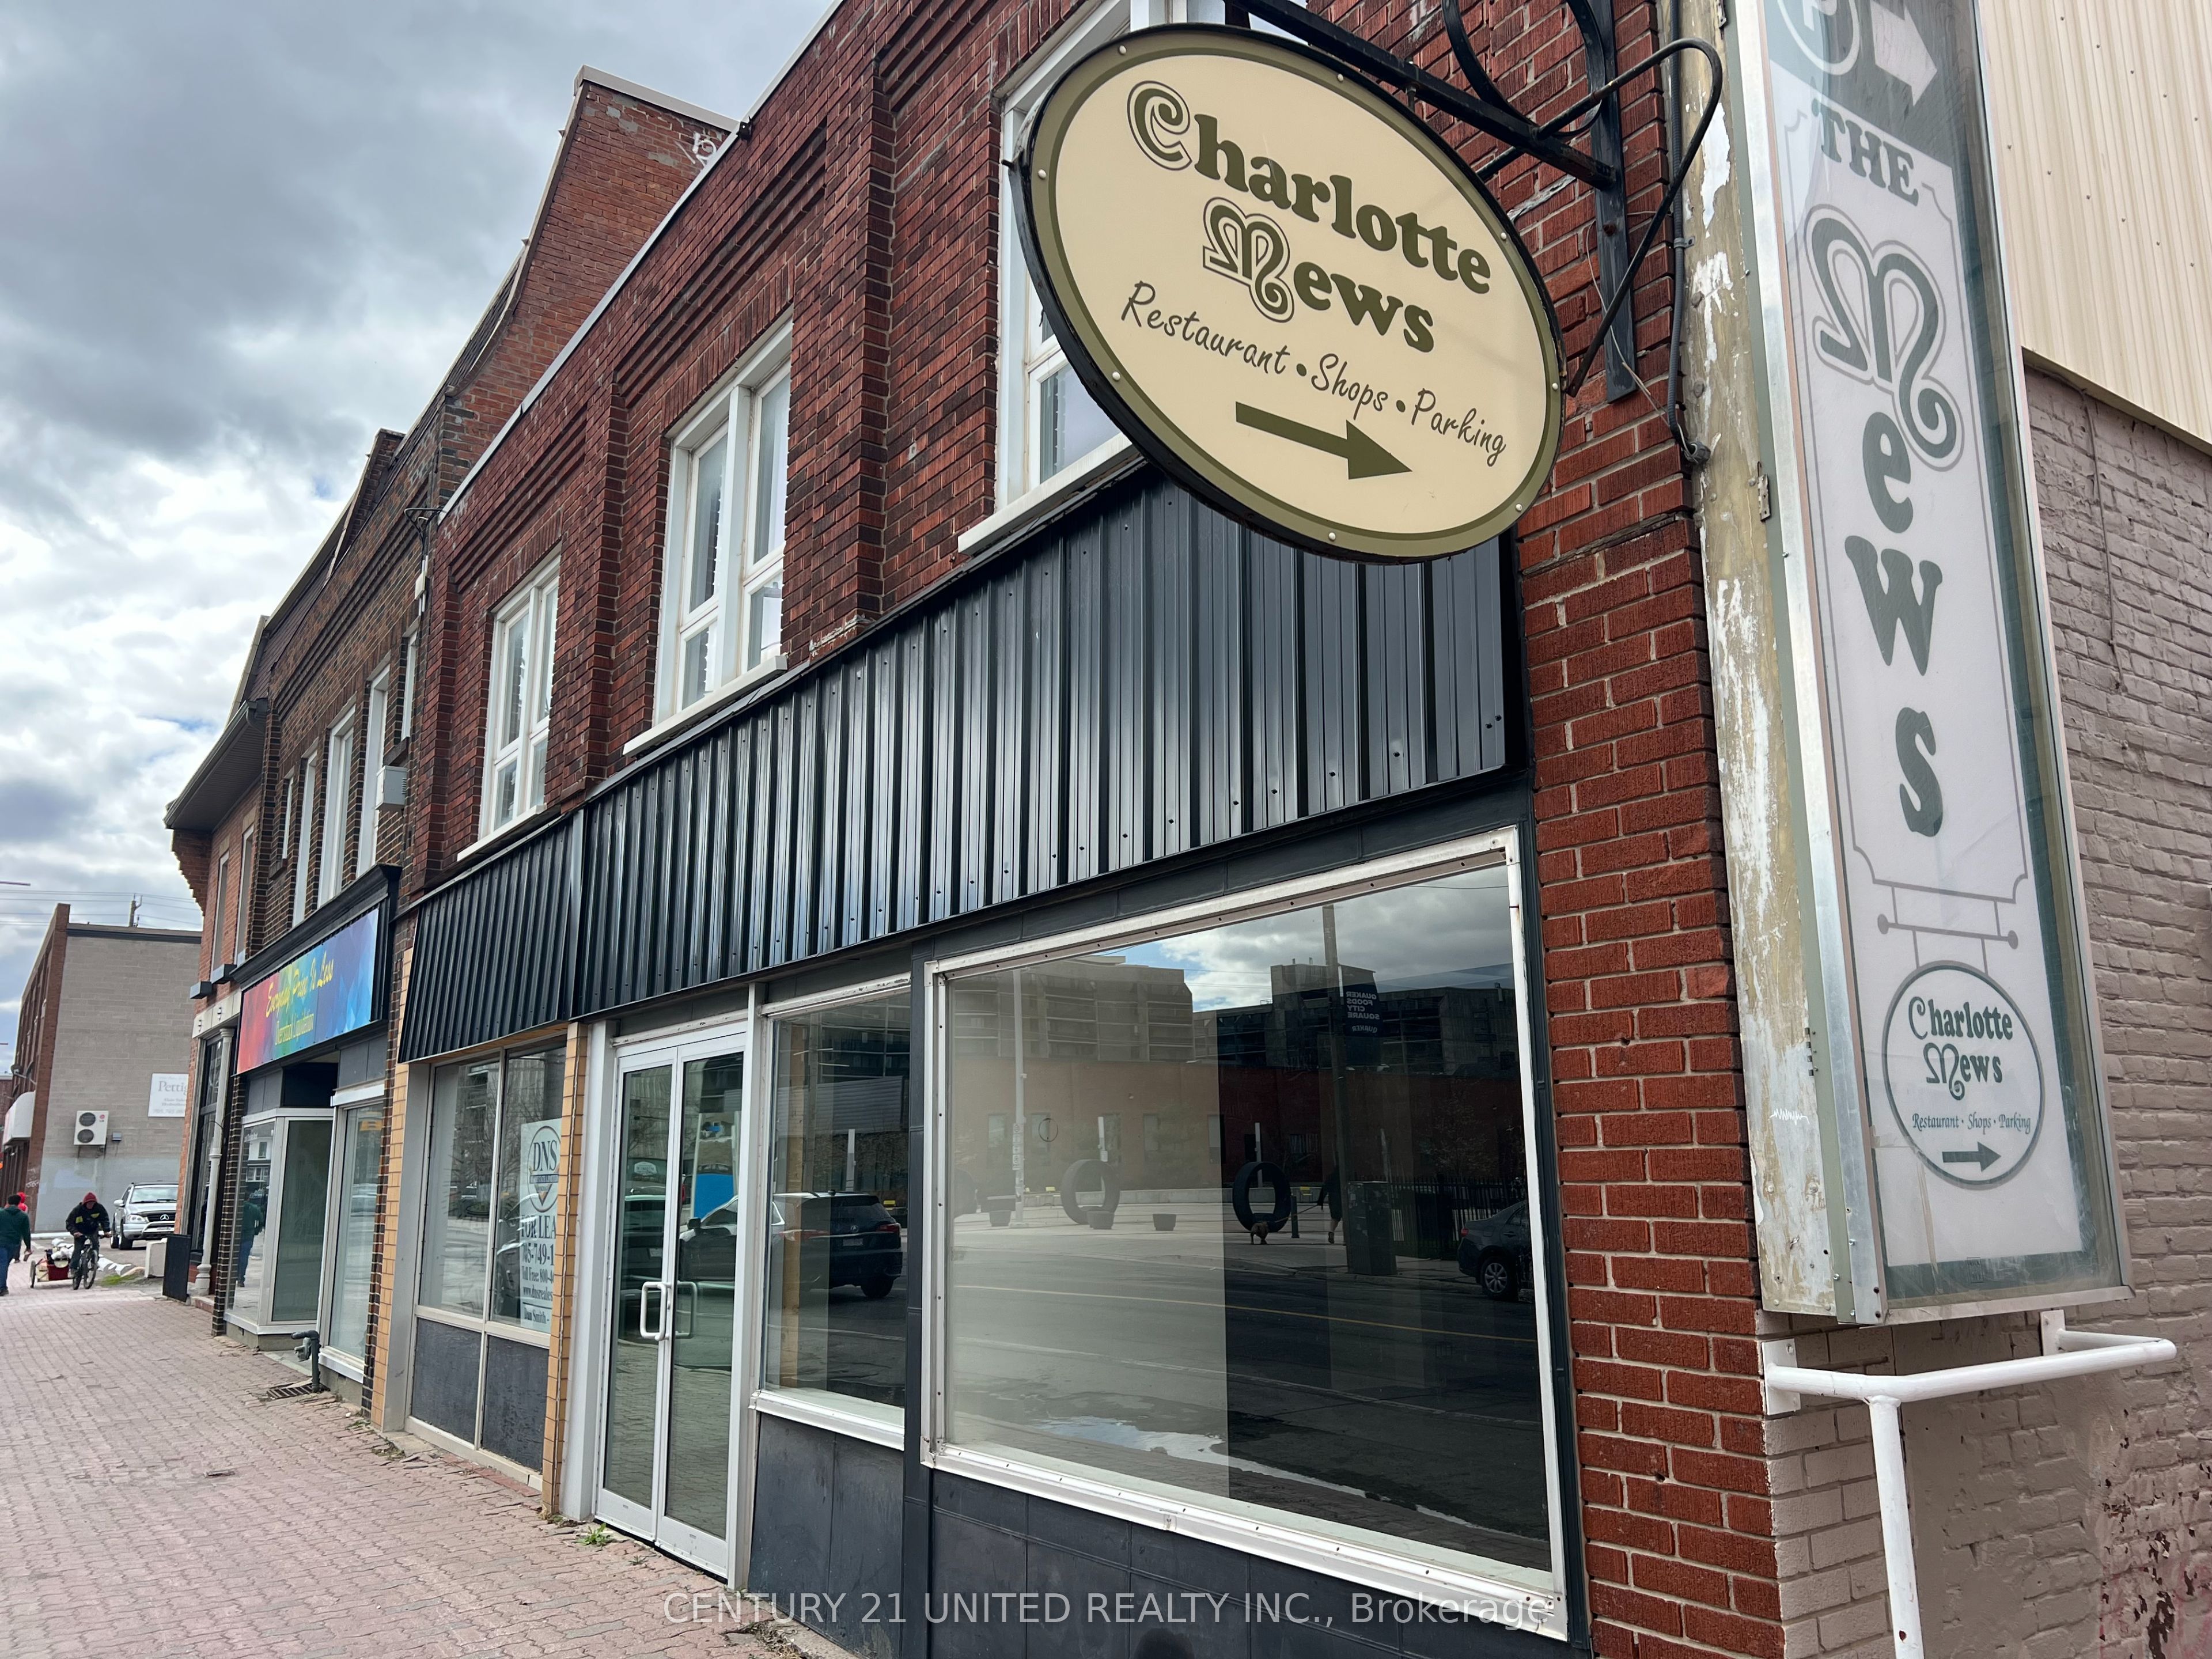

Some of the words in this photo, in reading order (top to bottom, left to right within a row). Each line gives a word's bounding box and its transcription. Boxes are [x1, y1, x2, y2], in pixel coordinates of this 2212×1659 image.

[1127, 80, 1491, 294] Charlotte
[1811, 97, 1919, 206] THE
[1203, 196, 1434, 353] Mews
[1122, 281, 1290, 375] Restaurant
[1310, 353, 1390, 421] Shops
[1409, 388, 1506, 467] Parking
[1804, 204, 1964, 837] Mews
[1908, 996, 2013, 1040] Charlotte
[1923, 1042, 2003, 1100] Mews
[533, 1139, 558, 1172] DNS
[1912, 1113, 1959, 1130] Restaurant
[1967, 1111, 1992, 1134] Shops
[1998, 1113, 2031, 1135] Parking
[521, 1214, 537, 1238] FOR
